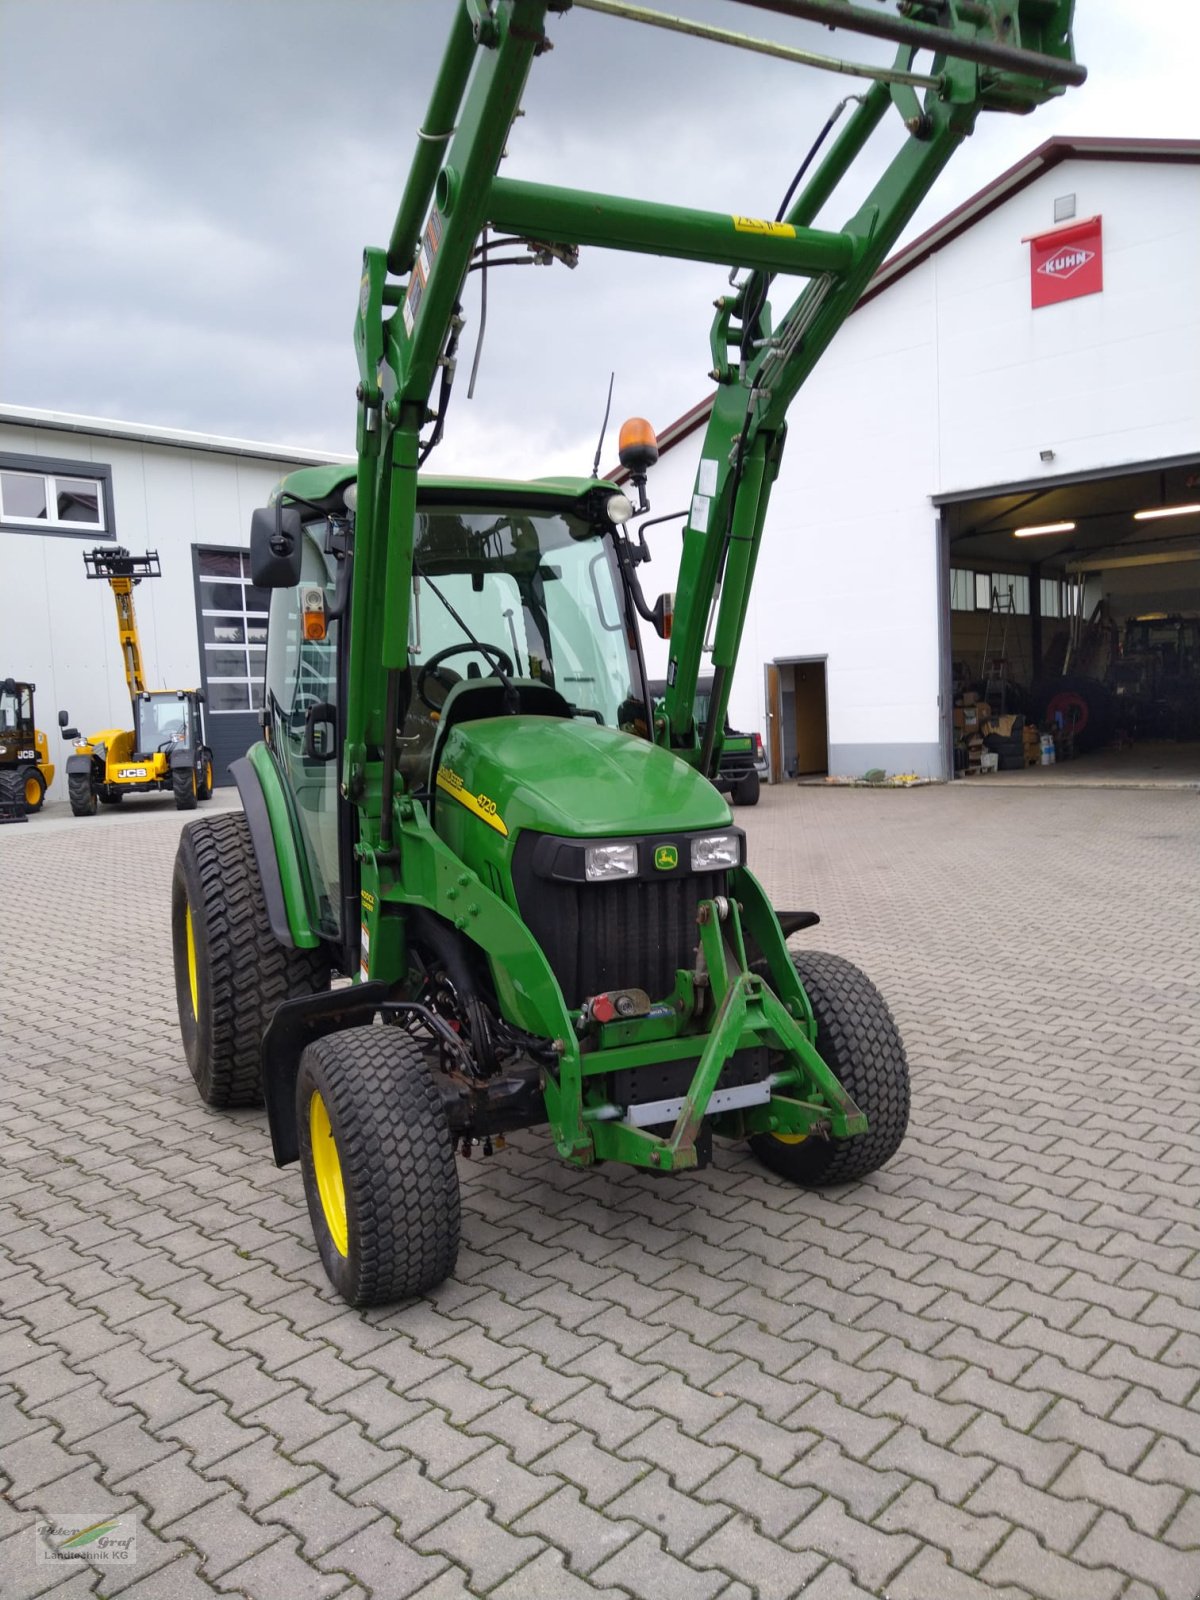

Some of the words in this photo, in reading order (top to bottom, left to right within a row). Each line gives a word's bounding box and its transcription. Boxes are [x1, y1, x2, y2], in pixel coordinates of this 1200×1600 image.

[1045, 251, 1086, 273] KUHN
[17, 750, 35, 759] JCB
[118, 768, 147, 778] JCB
[477, 794, 497, 815] 4720
